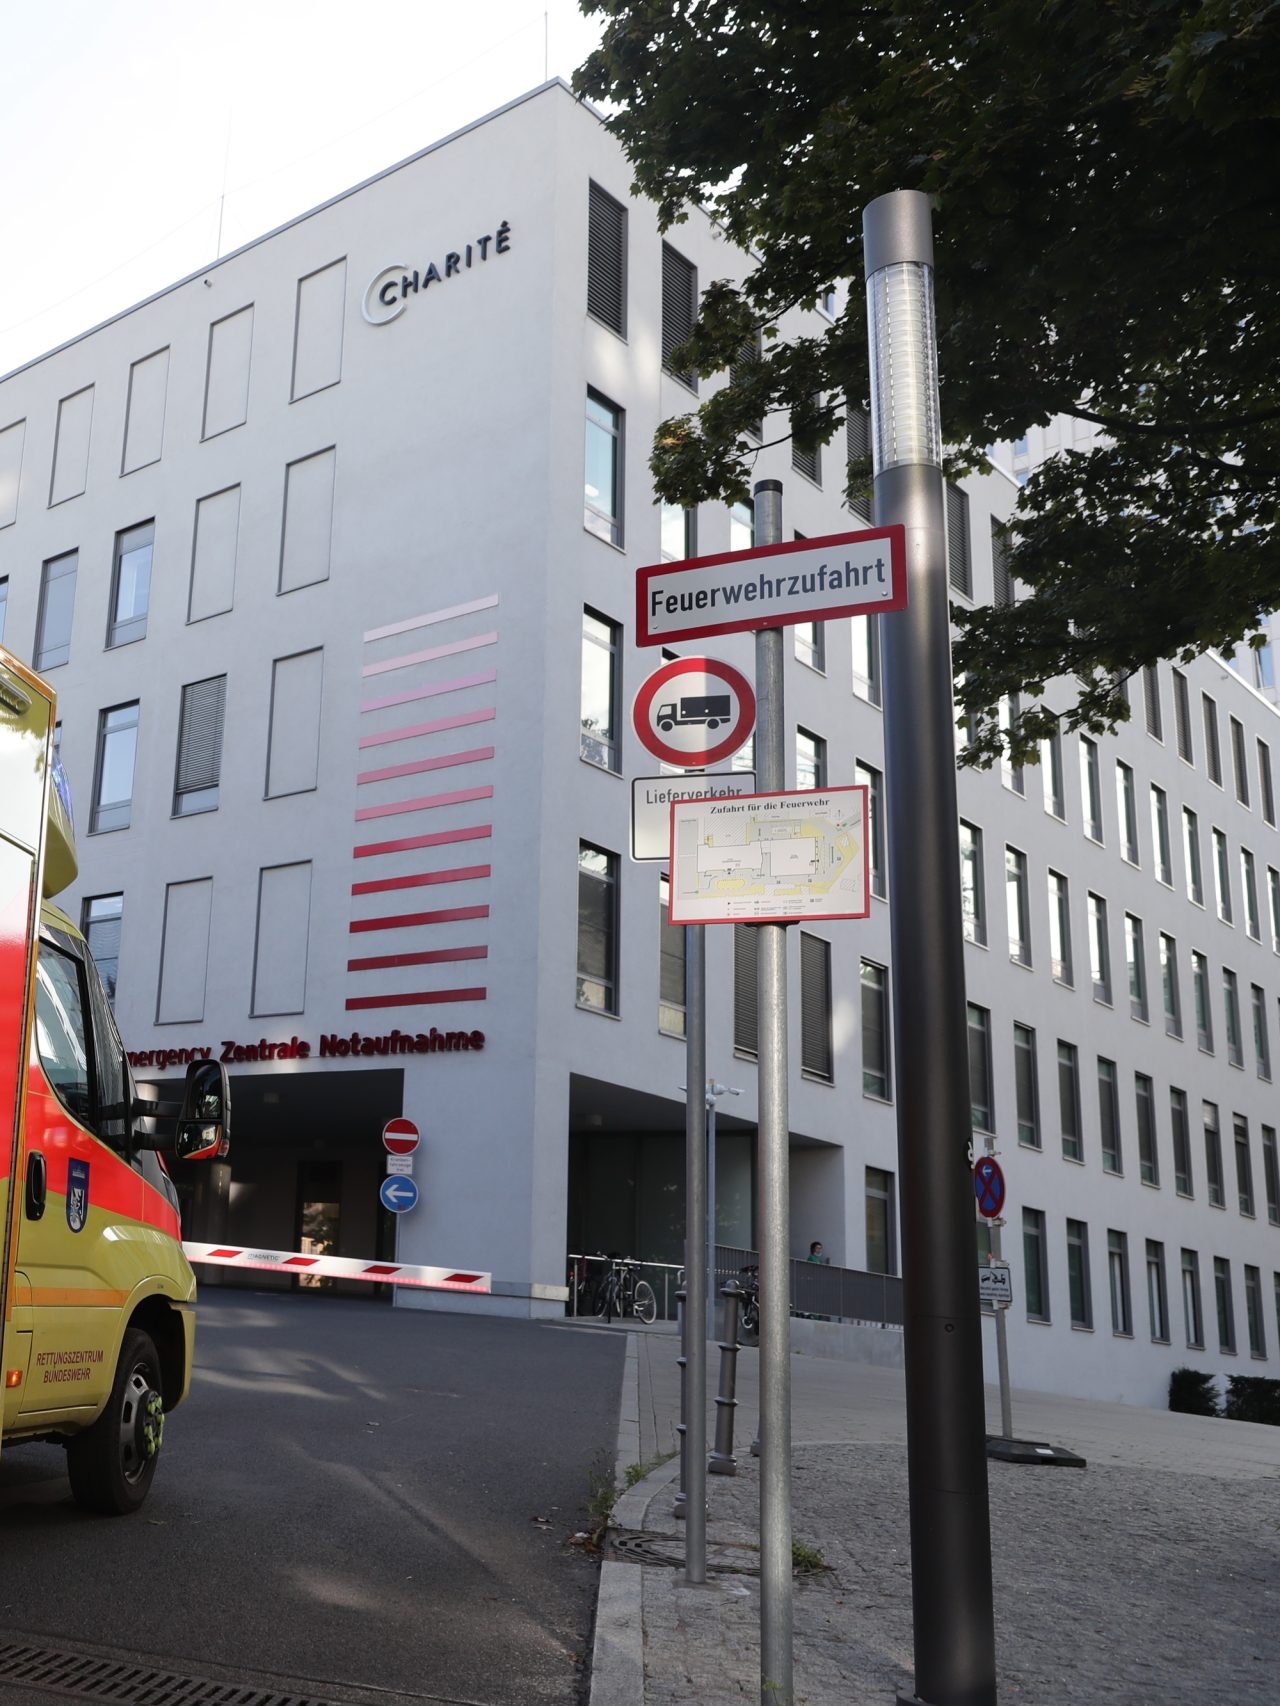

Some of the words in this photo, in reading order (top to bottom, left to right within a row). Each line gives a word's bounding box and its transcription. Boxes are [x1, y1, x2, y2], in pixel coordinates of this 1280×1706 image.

[379, 219, 511, 306] CHARITÉ
[650, 557, 886, 617] Feuerwehrzufahrt
[646, 785, 742, 804] Lieferverkehr
[710, 803, 746, 814] Zufahrt
[747, 802, 762, 812] für
[764, 801, 778, 810] die
[780, 798, 830, 809] Feuerwehr
[127, 1046, 211, 1070] mergency
[220, 1035, 311, 1063] Zentrale
[319, 1026, 486, 1058] Notaufnahme
[36, 1350, 104, 1366] RETTUNGSZENTRUM
[43, 1368, 91, 1383] BUNDESWEHR
